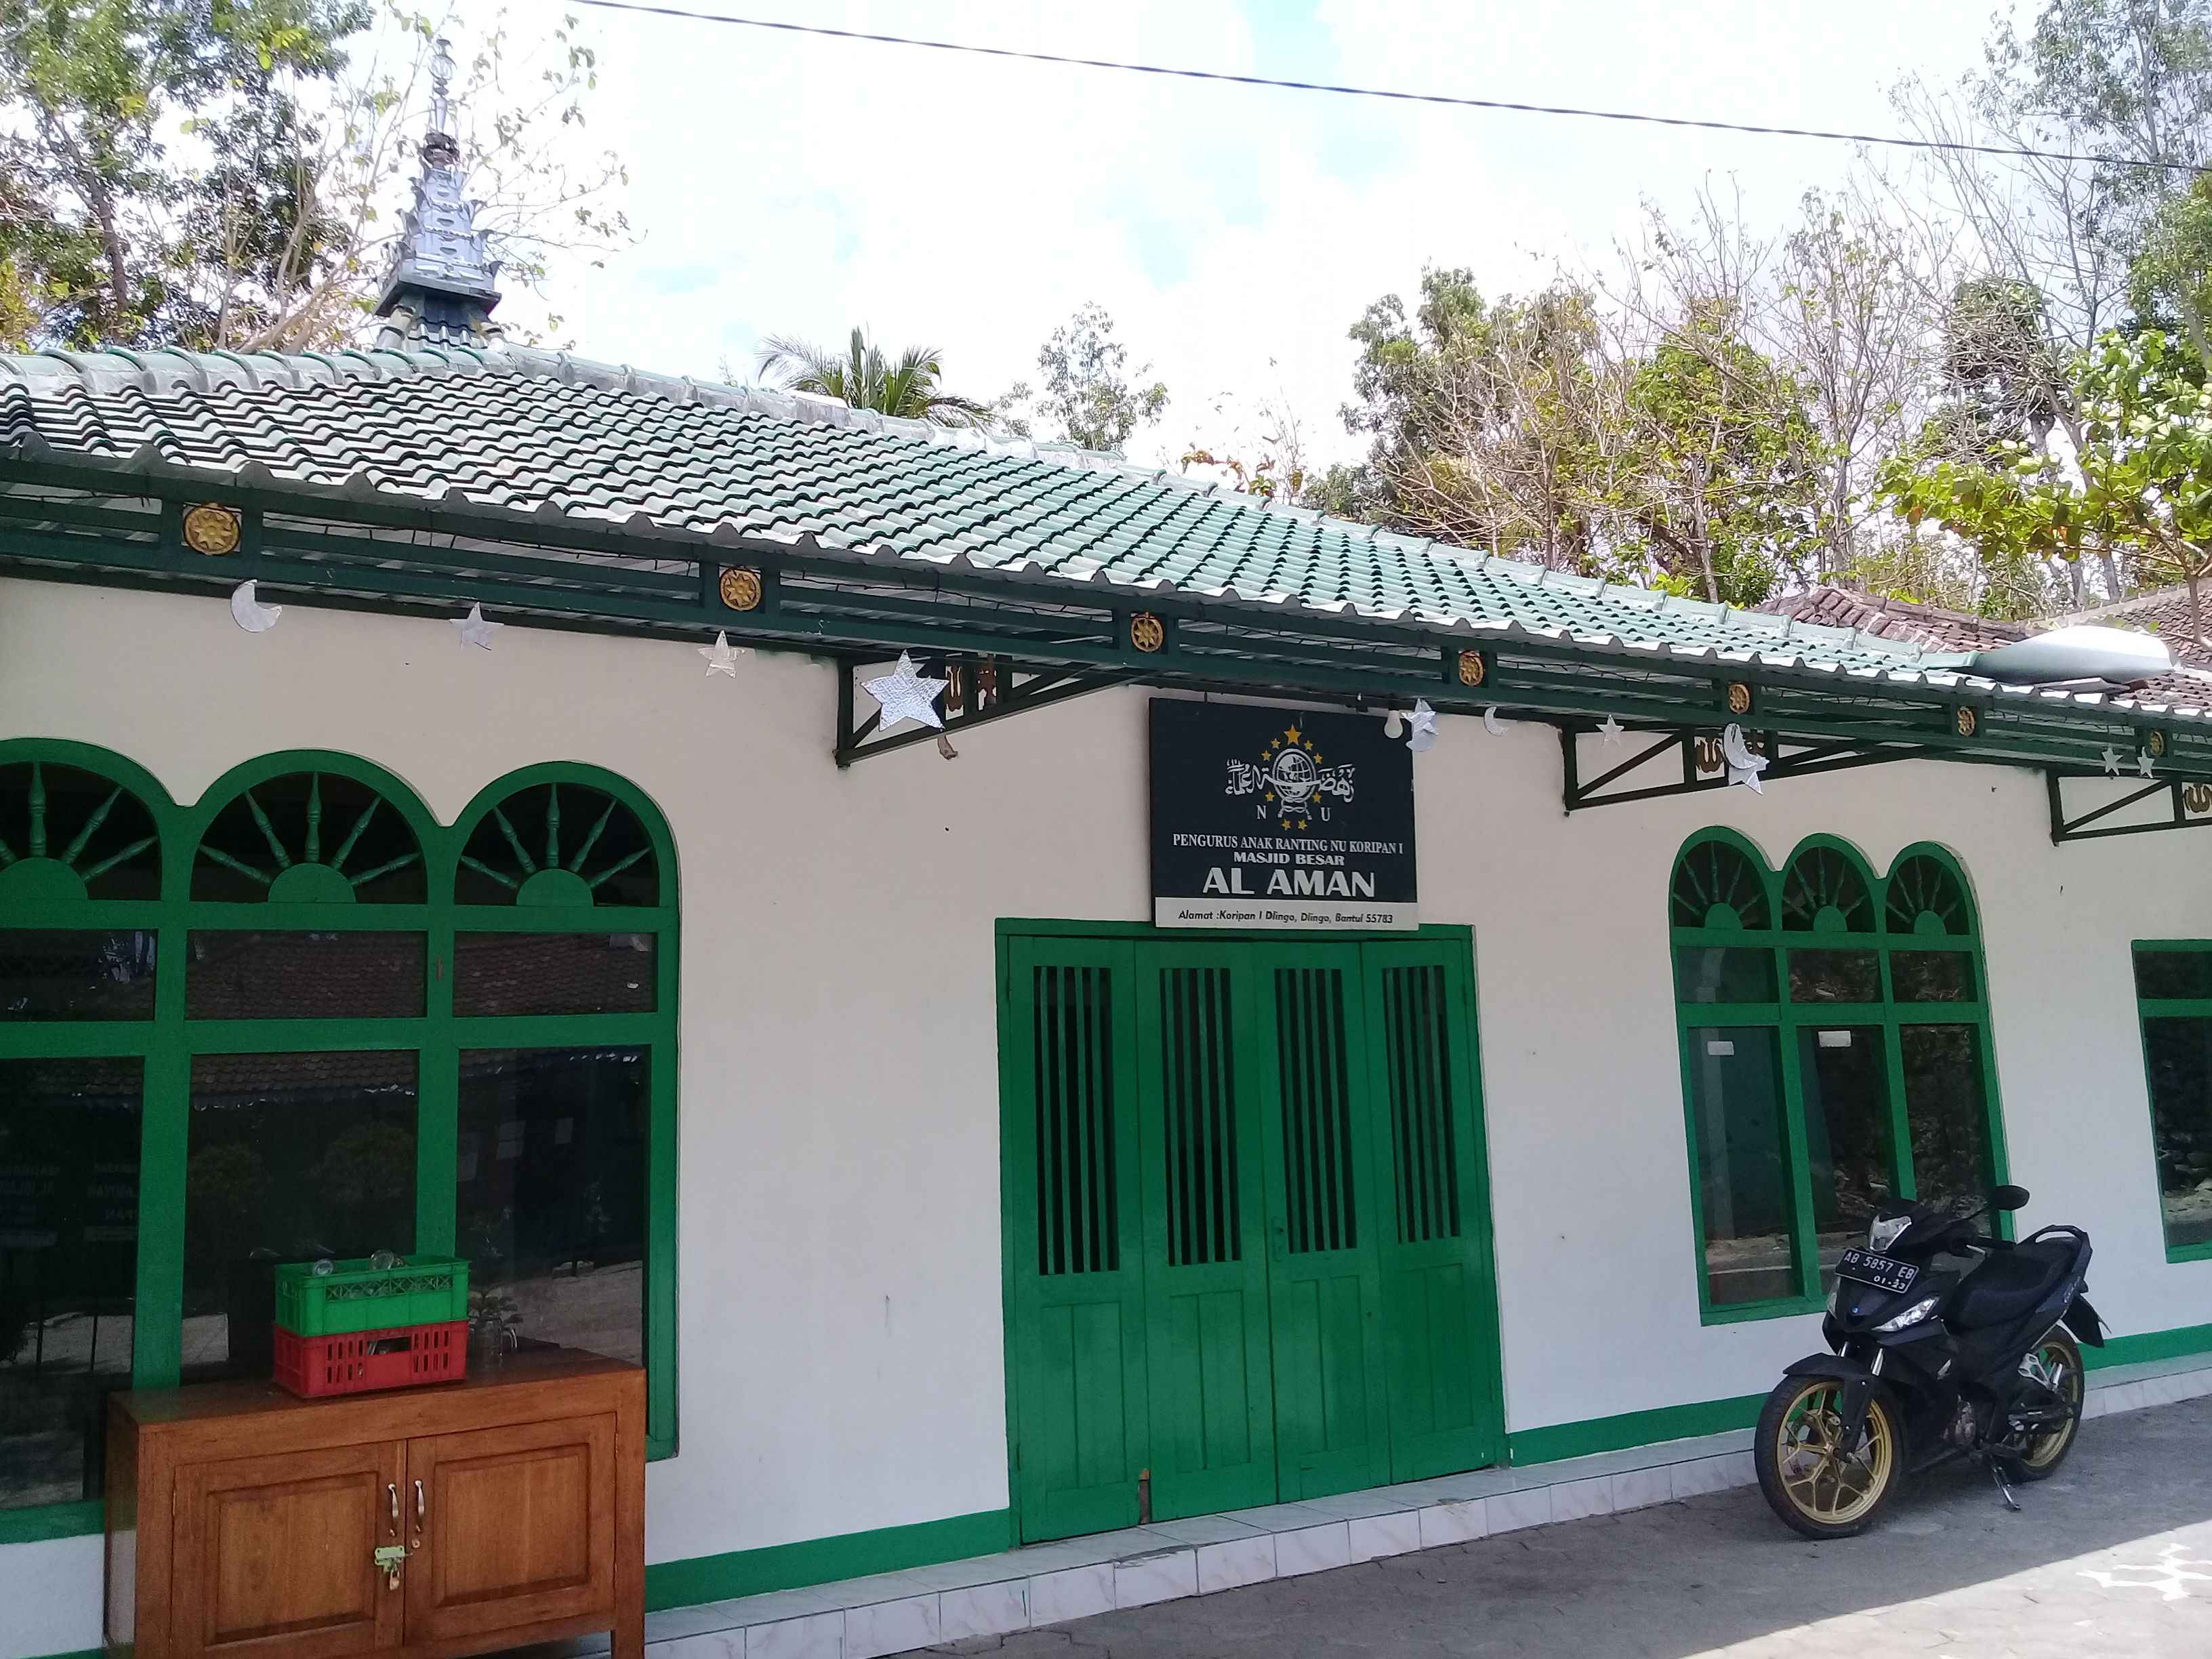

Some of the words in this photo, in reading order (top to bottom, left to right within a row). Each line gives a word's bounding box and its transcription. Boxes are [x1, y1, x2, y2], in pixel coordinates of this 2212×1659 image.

[1256, 804, 1267, 819] N
[1321, 807, 1330, 821] U
[1173, 834, 1238, 848] PENGURUS
[1240, 836, 1273, 849] ANAK
[1275, 838, 1328, 851] RANTING
[1330, 840, 1347, 852] NU
[1349, 841, 1397, 854] KORIPAN
[1233, 851, 1290, 863] MASJID
[1295, 853, 1345, 865] BESAR
[1202, 867, 1255, 895] AL
[1266, 869, 1375, 897] AMAN
[1178, 909, 1214, 920] Alamat
[1265, 910, 1297, 922] Dlingo,
[1335, 914, 1363, 922] Bantul
[1366, 914, 1393, 924] 55783
[1843, 1252, 1860, 1263] AB
[1862, 1256, 1893, 1273] 5857
[1898, 1266, 1914, 1279] EB
